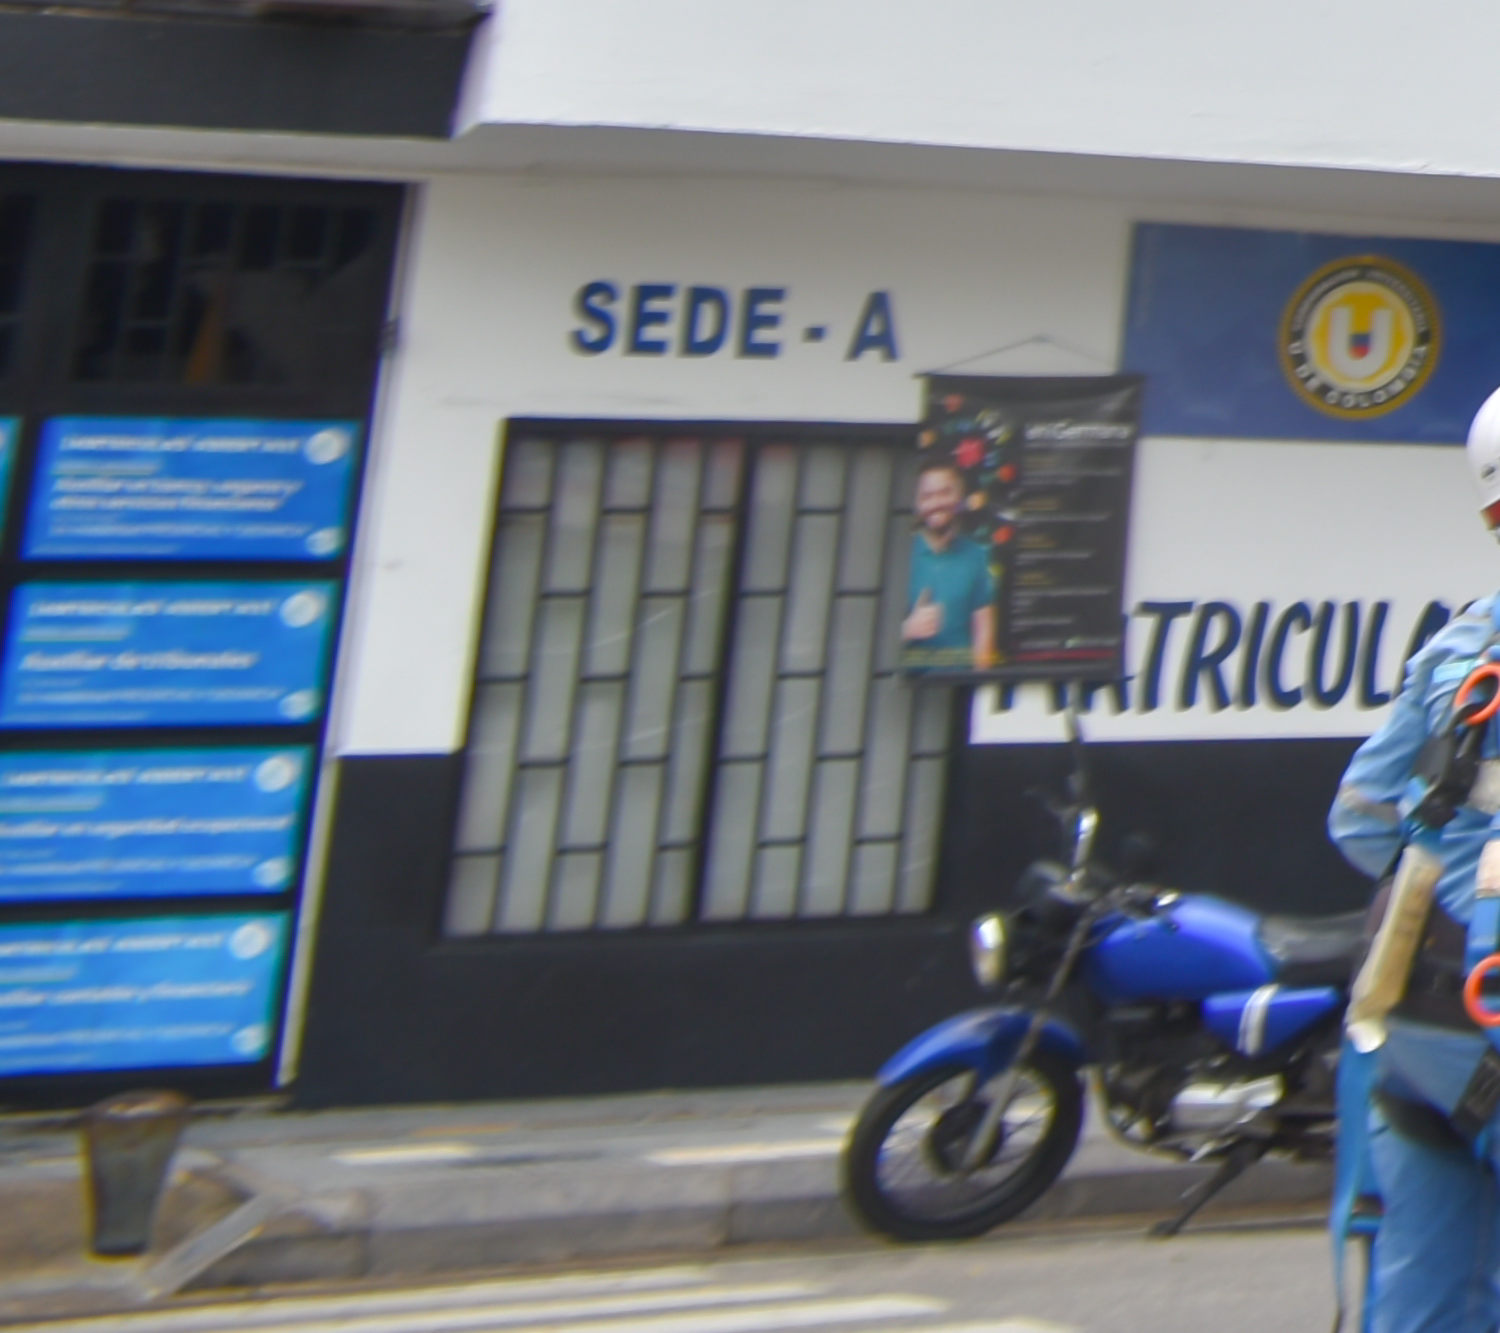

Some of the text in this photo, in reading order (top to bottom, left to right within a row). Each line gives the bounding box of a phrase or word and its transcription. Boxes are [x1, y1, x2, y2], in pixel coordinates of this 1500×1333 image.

[572, 280, 786, 360] SEDE
[850, 289, 900, 363] A
[994, 598, 1479, 713] TRICUL
